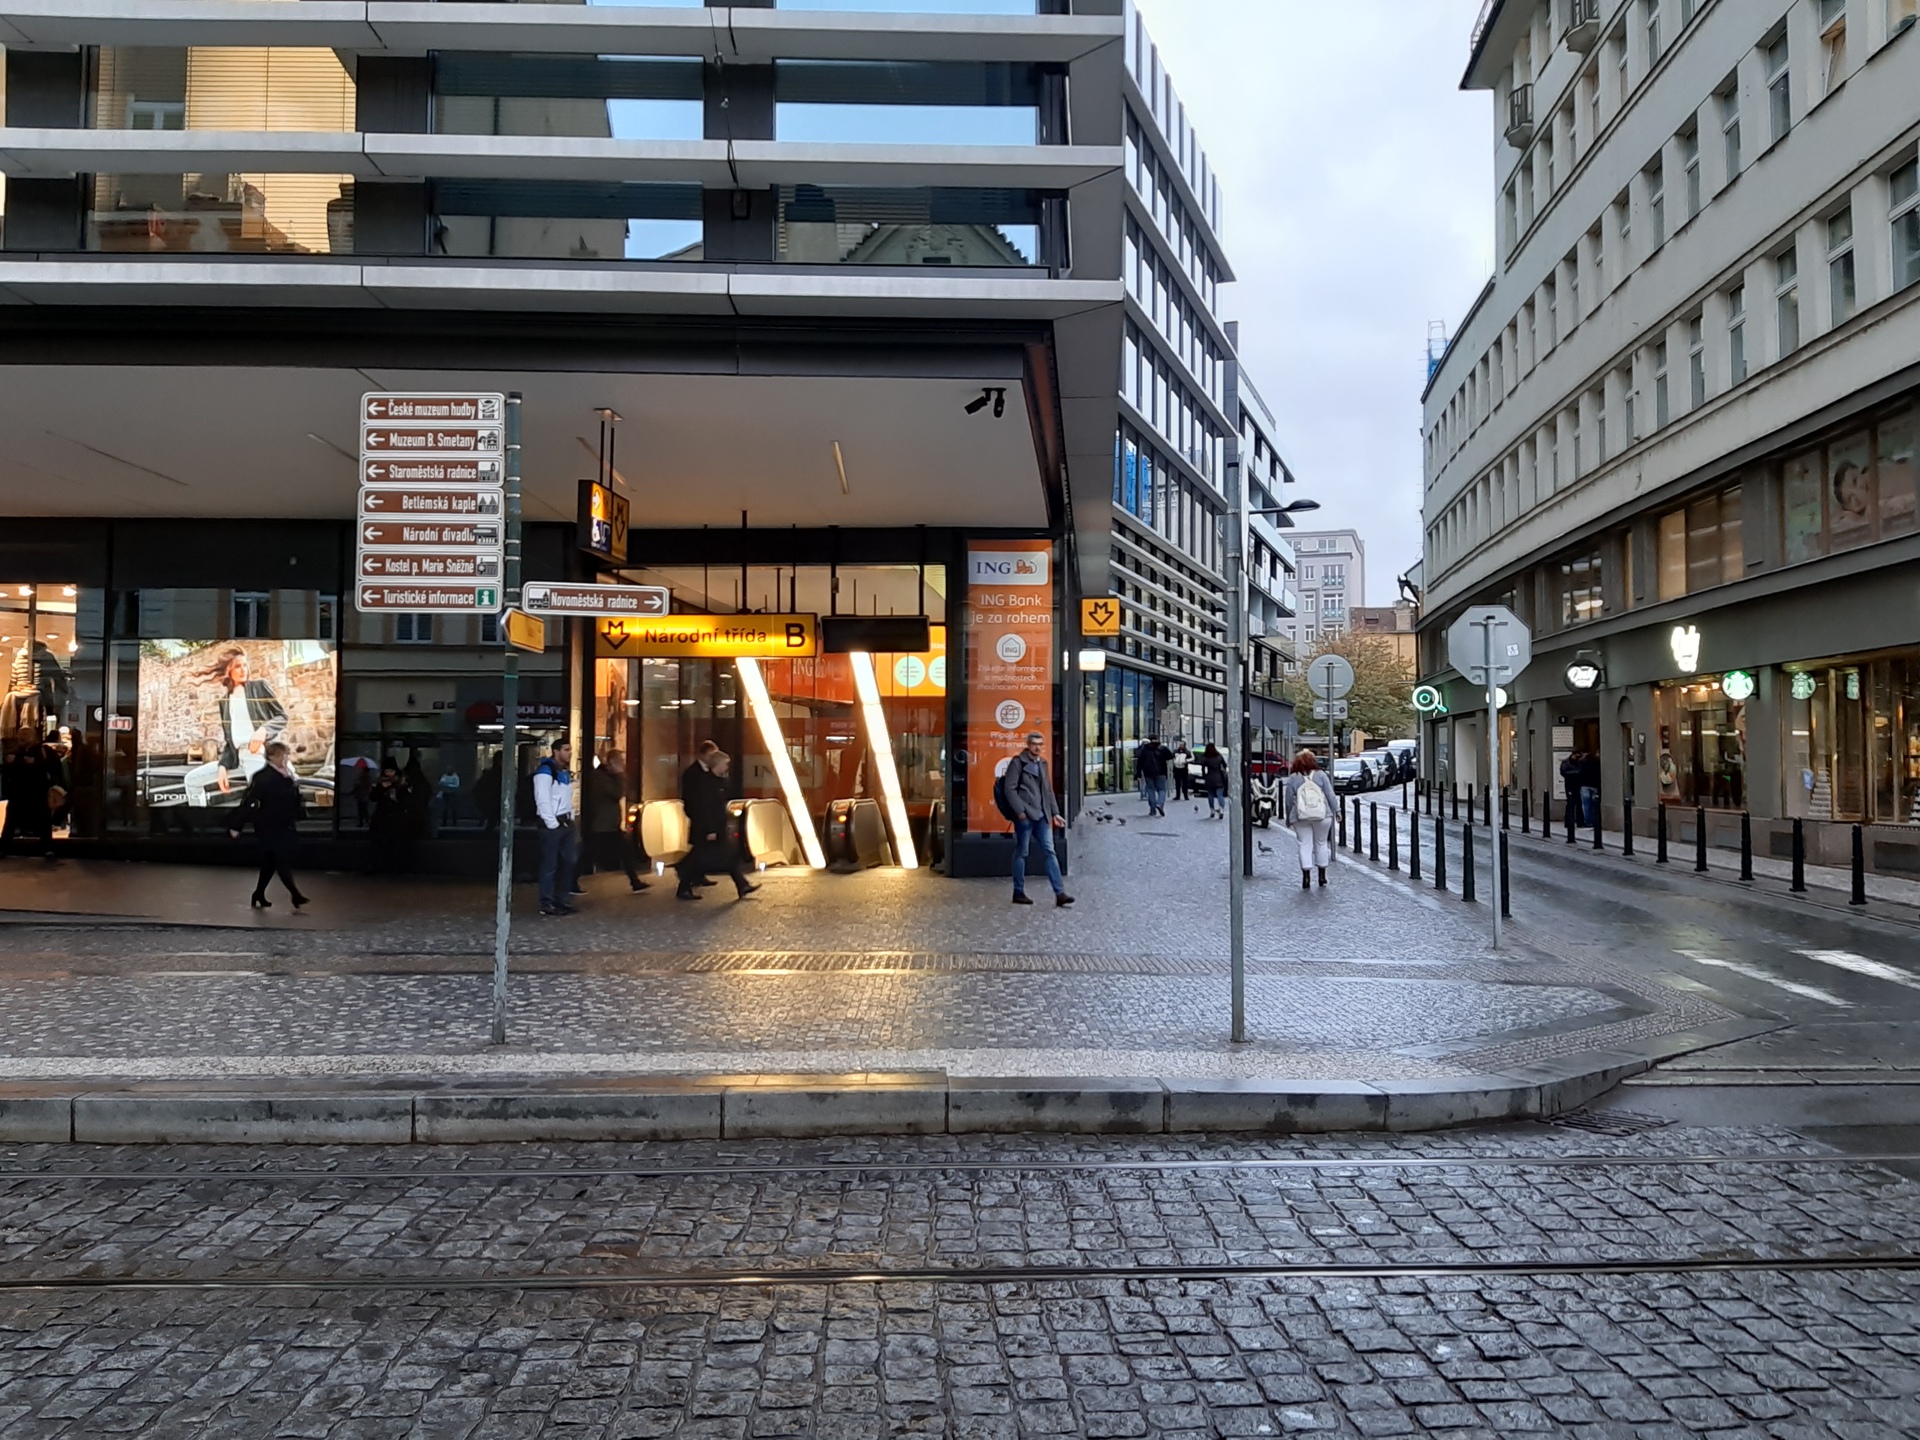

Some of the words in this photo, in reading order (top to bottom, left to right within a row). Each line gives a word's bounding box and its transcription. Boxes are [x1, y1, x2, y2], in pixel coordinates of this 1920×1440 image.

[388, 399, 413, 416] České
[414, 403, 450, 416] muzeum
[450, 402, 477, 419] hudby
[389, 432, 426, 447] Muzeum
[427, 432, 436, 447] B.
[437, 433, 476, 450] Smetany
[389, 464, 445, 479] Staroměstská
[446, 464, 477, 479] radnice
[402, 495, 449, 510] Betlémská
[451, 496, 476, 513] kaple
[403, 527, 440, 541] Národní
[442, 527, 475, 541] divadlo
[385, 558, 411, 573] Kostel
[412, 561, 420, 576] p.
[422, 558, 445, 573] Marie
[446, 559, 474, 573] Sněžné
[976, 561, 1012, 575] ING
[383, 589, 427, 604] Turistické
[428, 590, 474, 604] informace
[551, 592, 604, 608] Novoměstská
[607, 594, 638, 609] radnice
[981, 594, 1005, 606] ING
[1009, 594, 1042, 606] Bank
[970, 611, 984, 627] je
[987, 614, 1003, 624] za
[1007, 612, 1051, 624] rohem
[644, 627, 718, 644] Národní
[725, 627, 767, 643] třída
[785, 622, 806, 648] B
